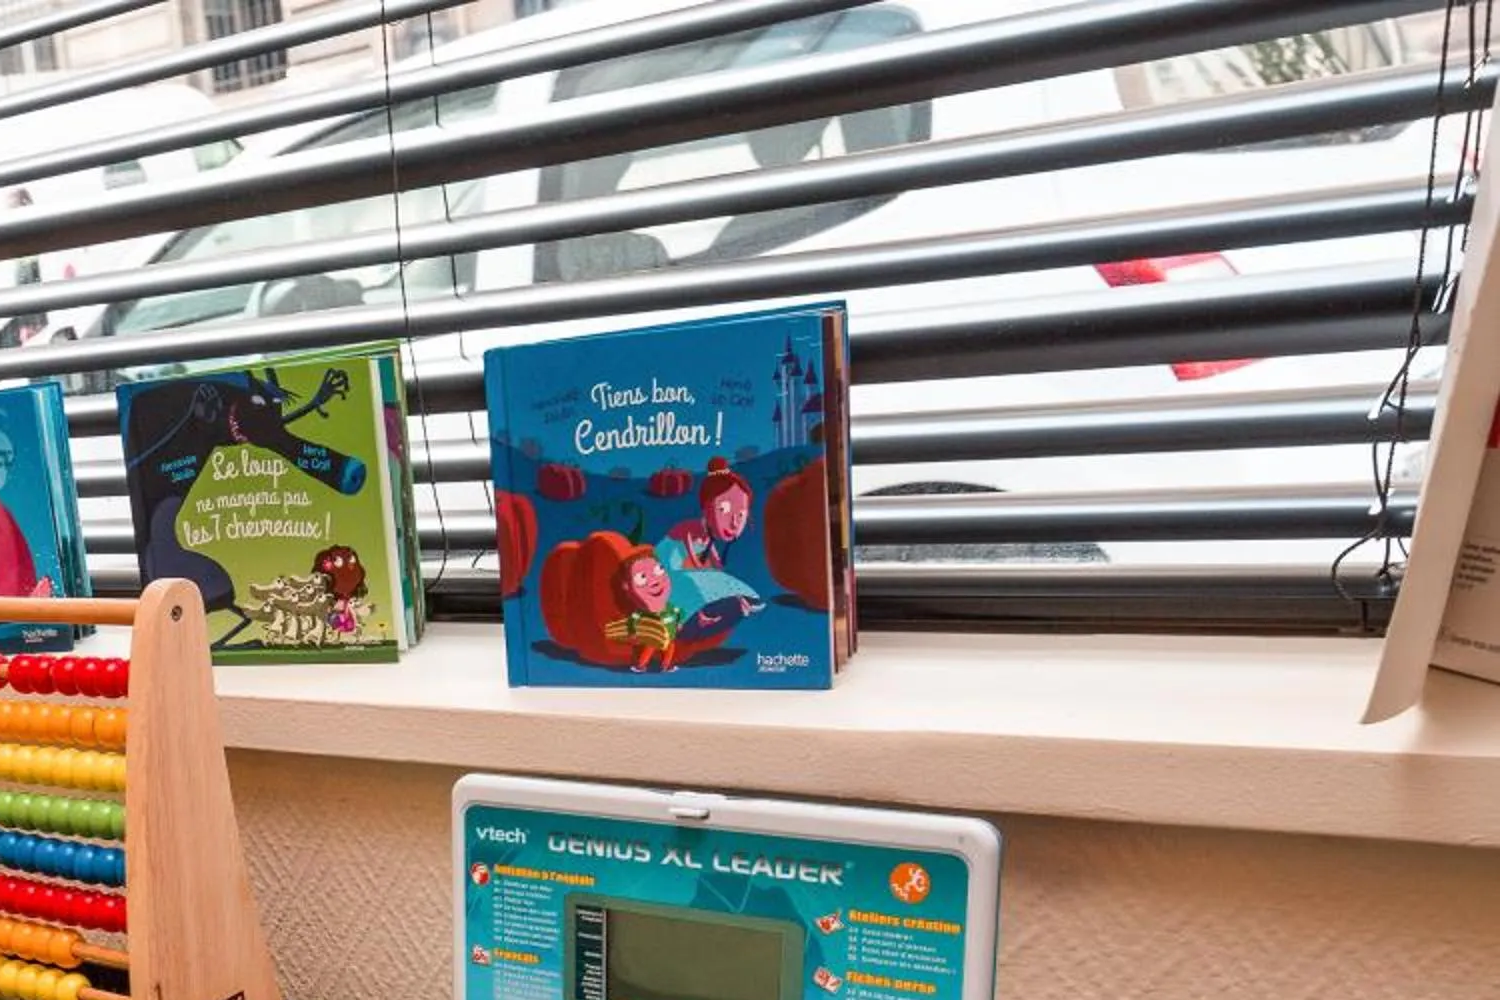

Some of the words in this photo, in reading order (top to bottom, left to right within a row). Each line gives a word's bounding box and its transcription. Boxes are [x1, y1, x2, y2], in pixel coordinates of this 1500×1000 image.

[591, 381, 649, 410] Tiens
[651, 377, 696, 405] bon,
[211, 451, 240, 482] Le
[242, 449, 288, 489] loup
[196, 499, 215, 512] ne
[216, 491, 281, 517] mangera
[283, 490, 312, 514] pas
[182, 520, 214, 547] les
[755, 651, 810, 667] hachette
[476, 826, 528, 845] vtech
[547, 831, 651, 862] GENIUS
[660, 842, 703, 869] XL
[712, 846, 844, 886] LEADER
